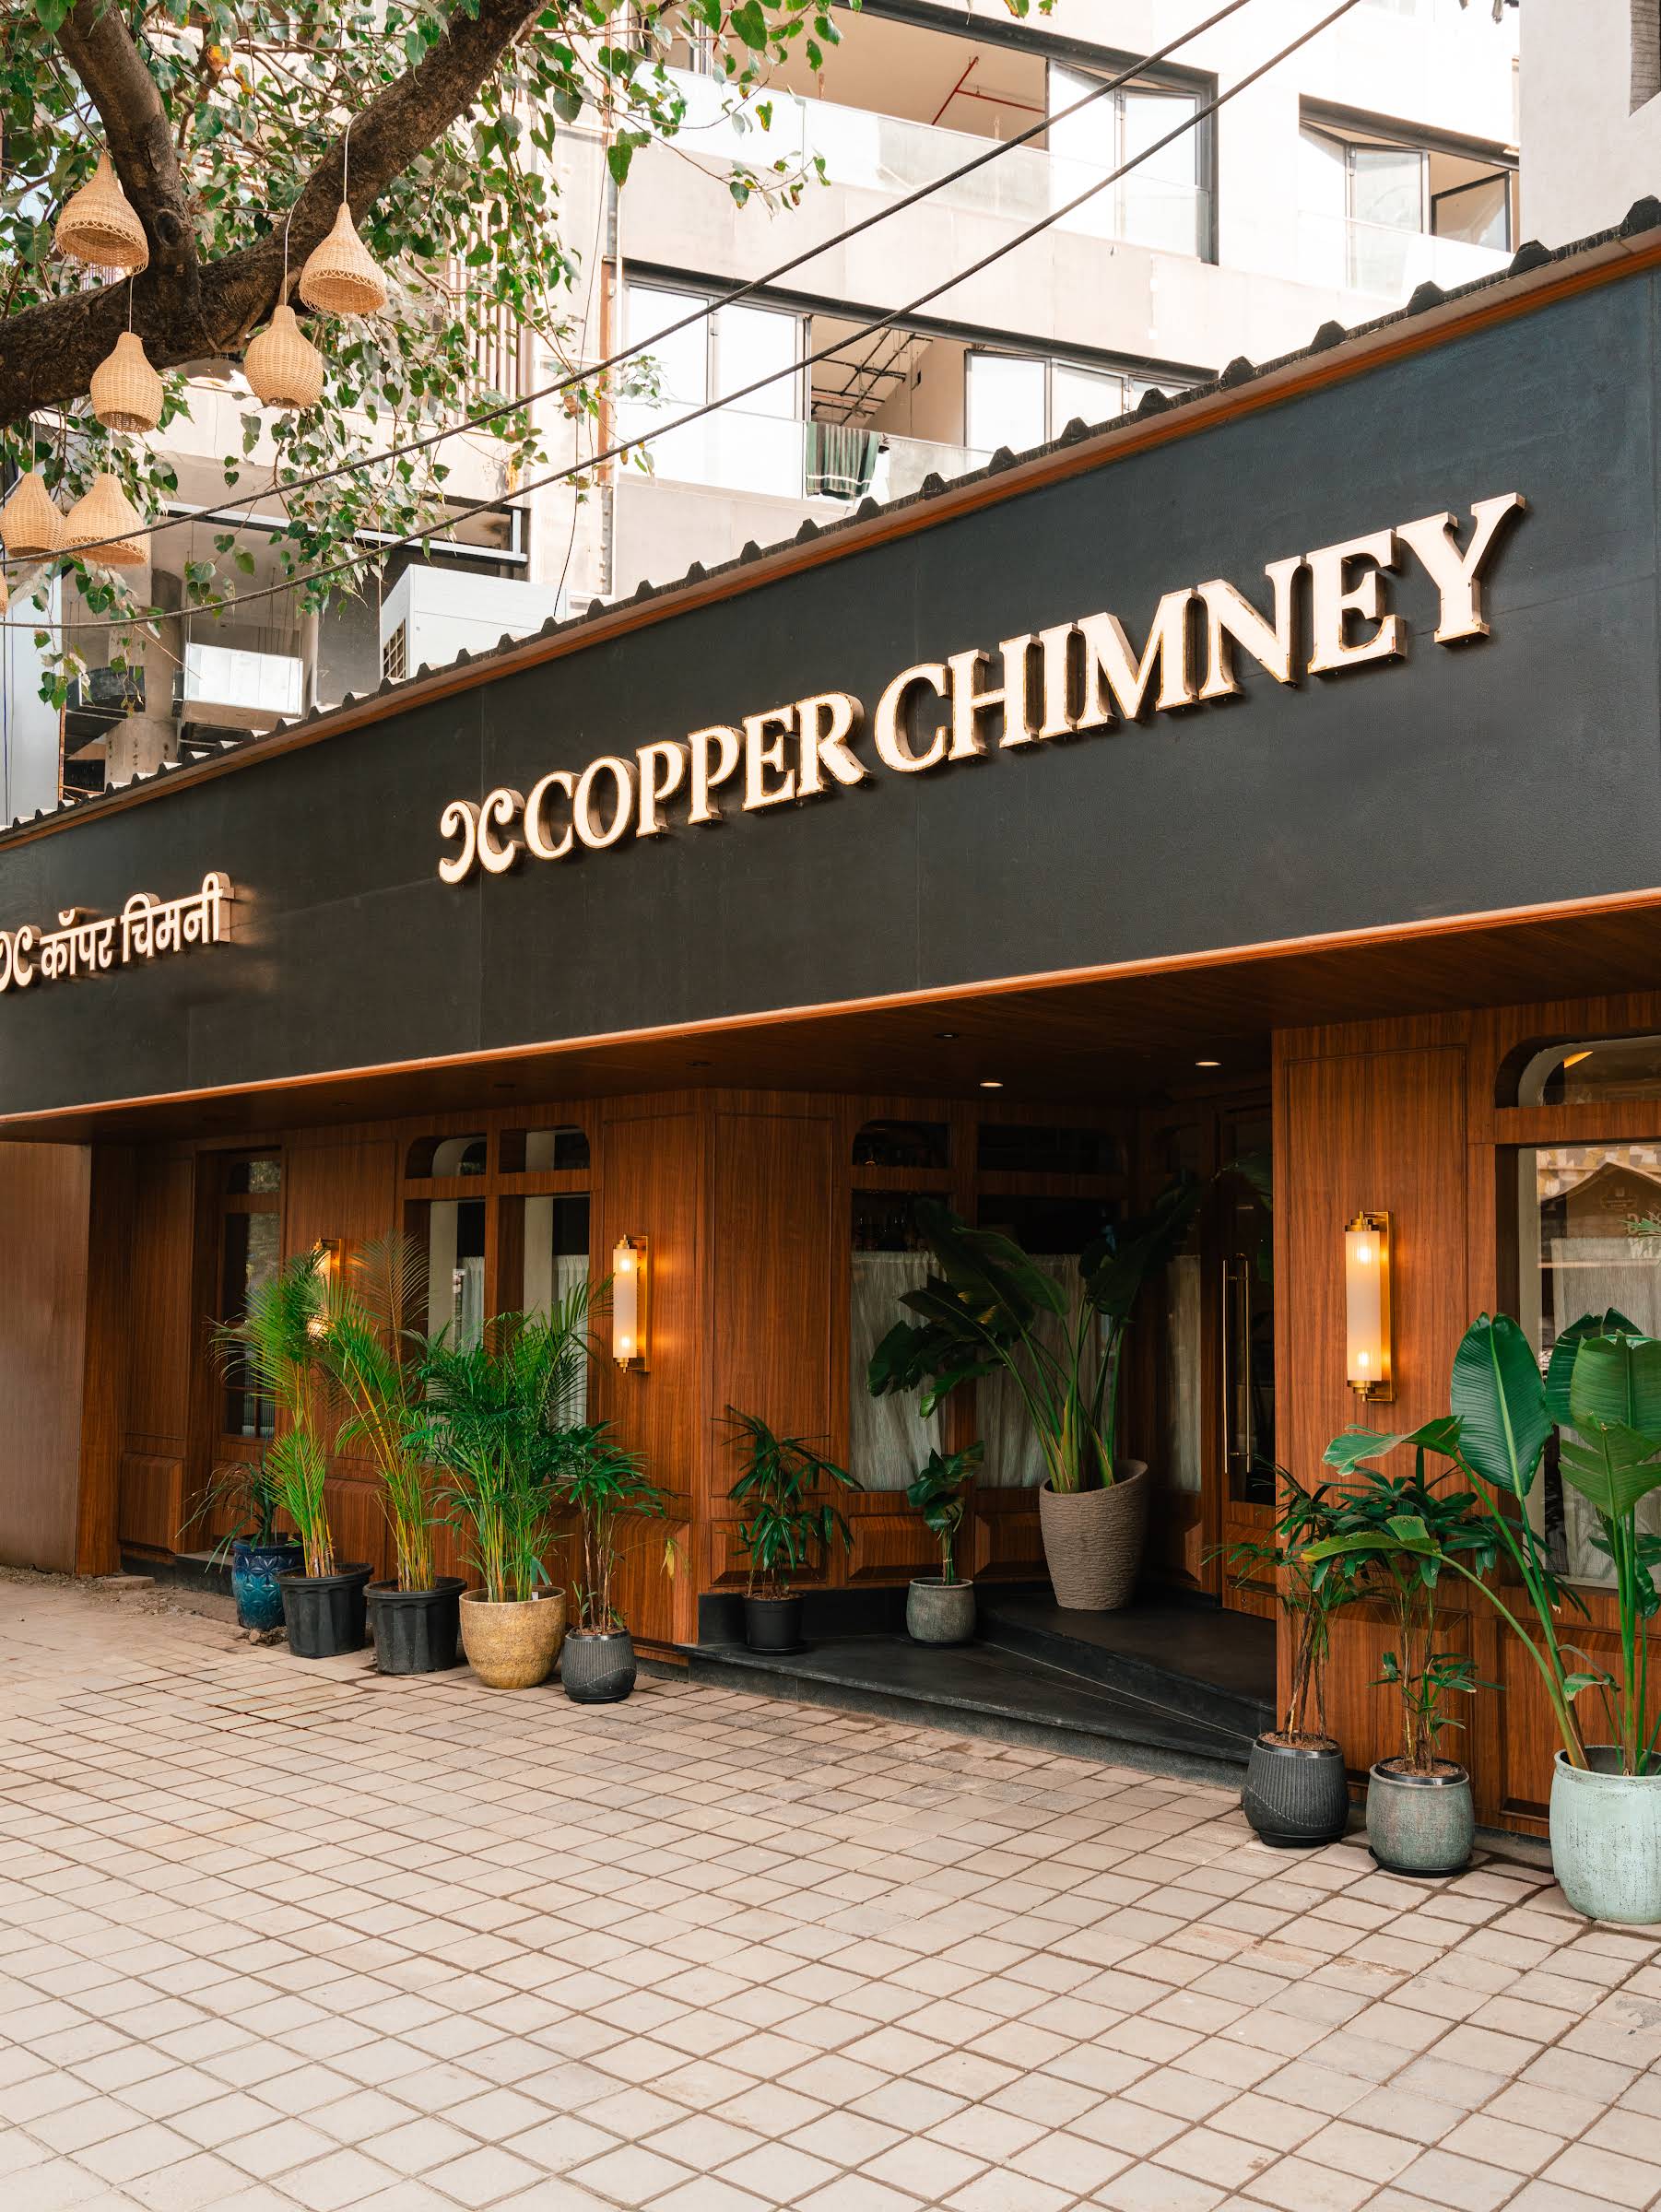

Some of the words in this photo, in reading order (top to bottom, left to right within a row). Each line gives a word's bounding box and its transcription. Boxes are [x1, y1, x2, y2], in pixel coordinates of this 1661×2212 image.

[524, 691, 870, 860] COPPER
[875, 493, 1526, 773] CHIMNEY
[40, 907, 116, 980] कॉपर
[120, 871, 234, 962] चिमनी
